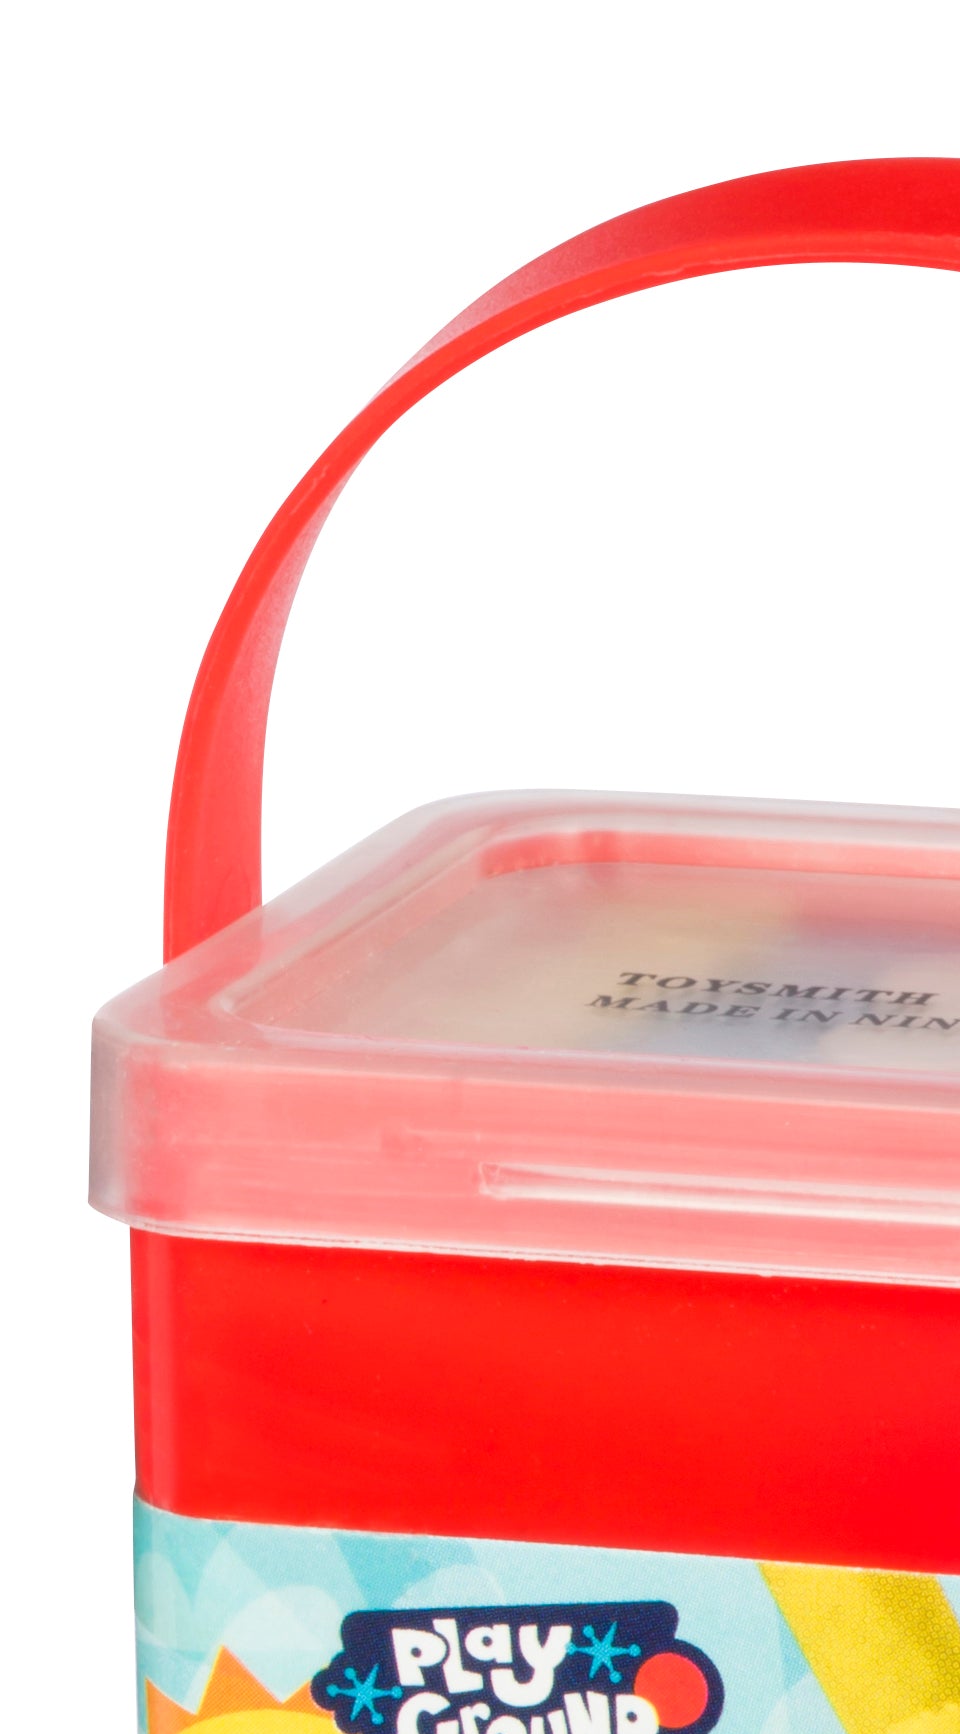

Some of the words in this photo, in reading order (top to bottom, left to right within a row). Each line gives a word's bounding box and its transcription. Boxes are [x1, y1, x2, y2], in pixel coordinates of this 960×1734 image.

[616, 972, 940, 1007] TOYSMITH
[587, 993, 762, 1021] MADE
[772, 1008, 842, 1024] IN
